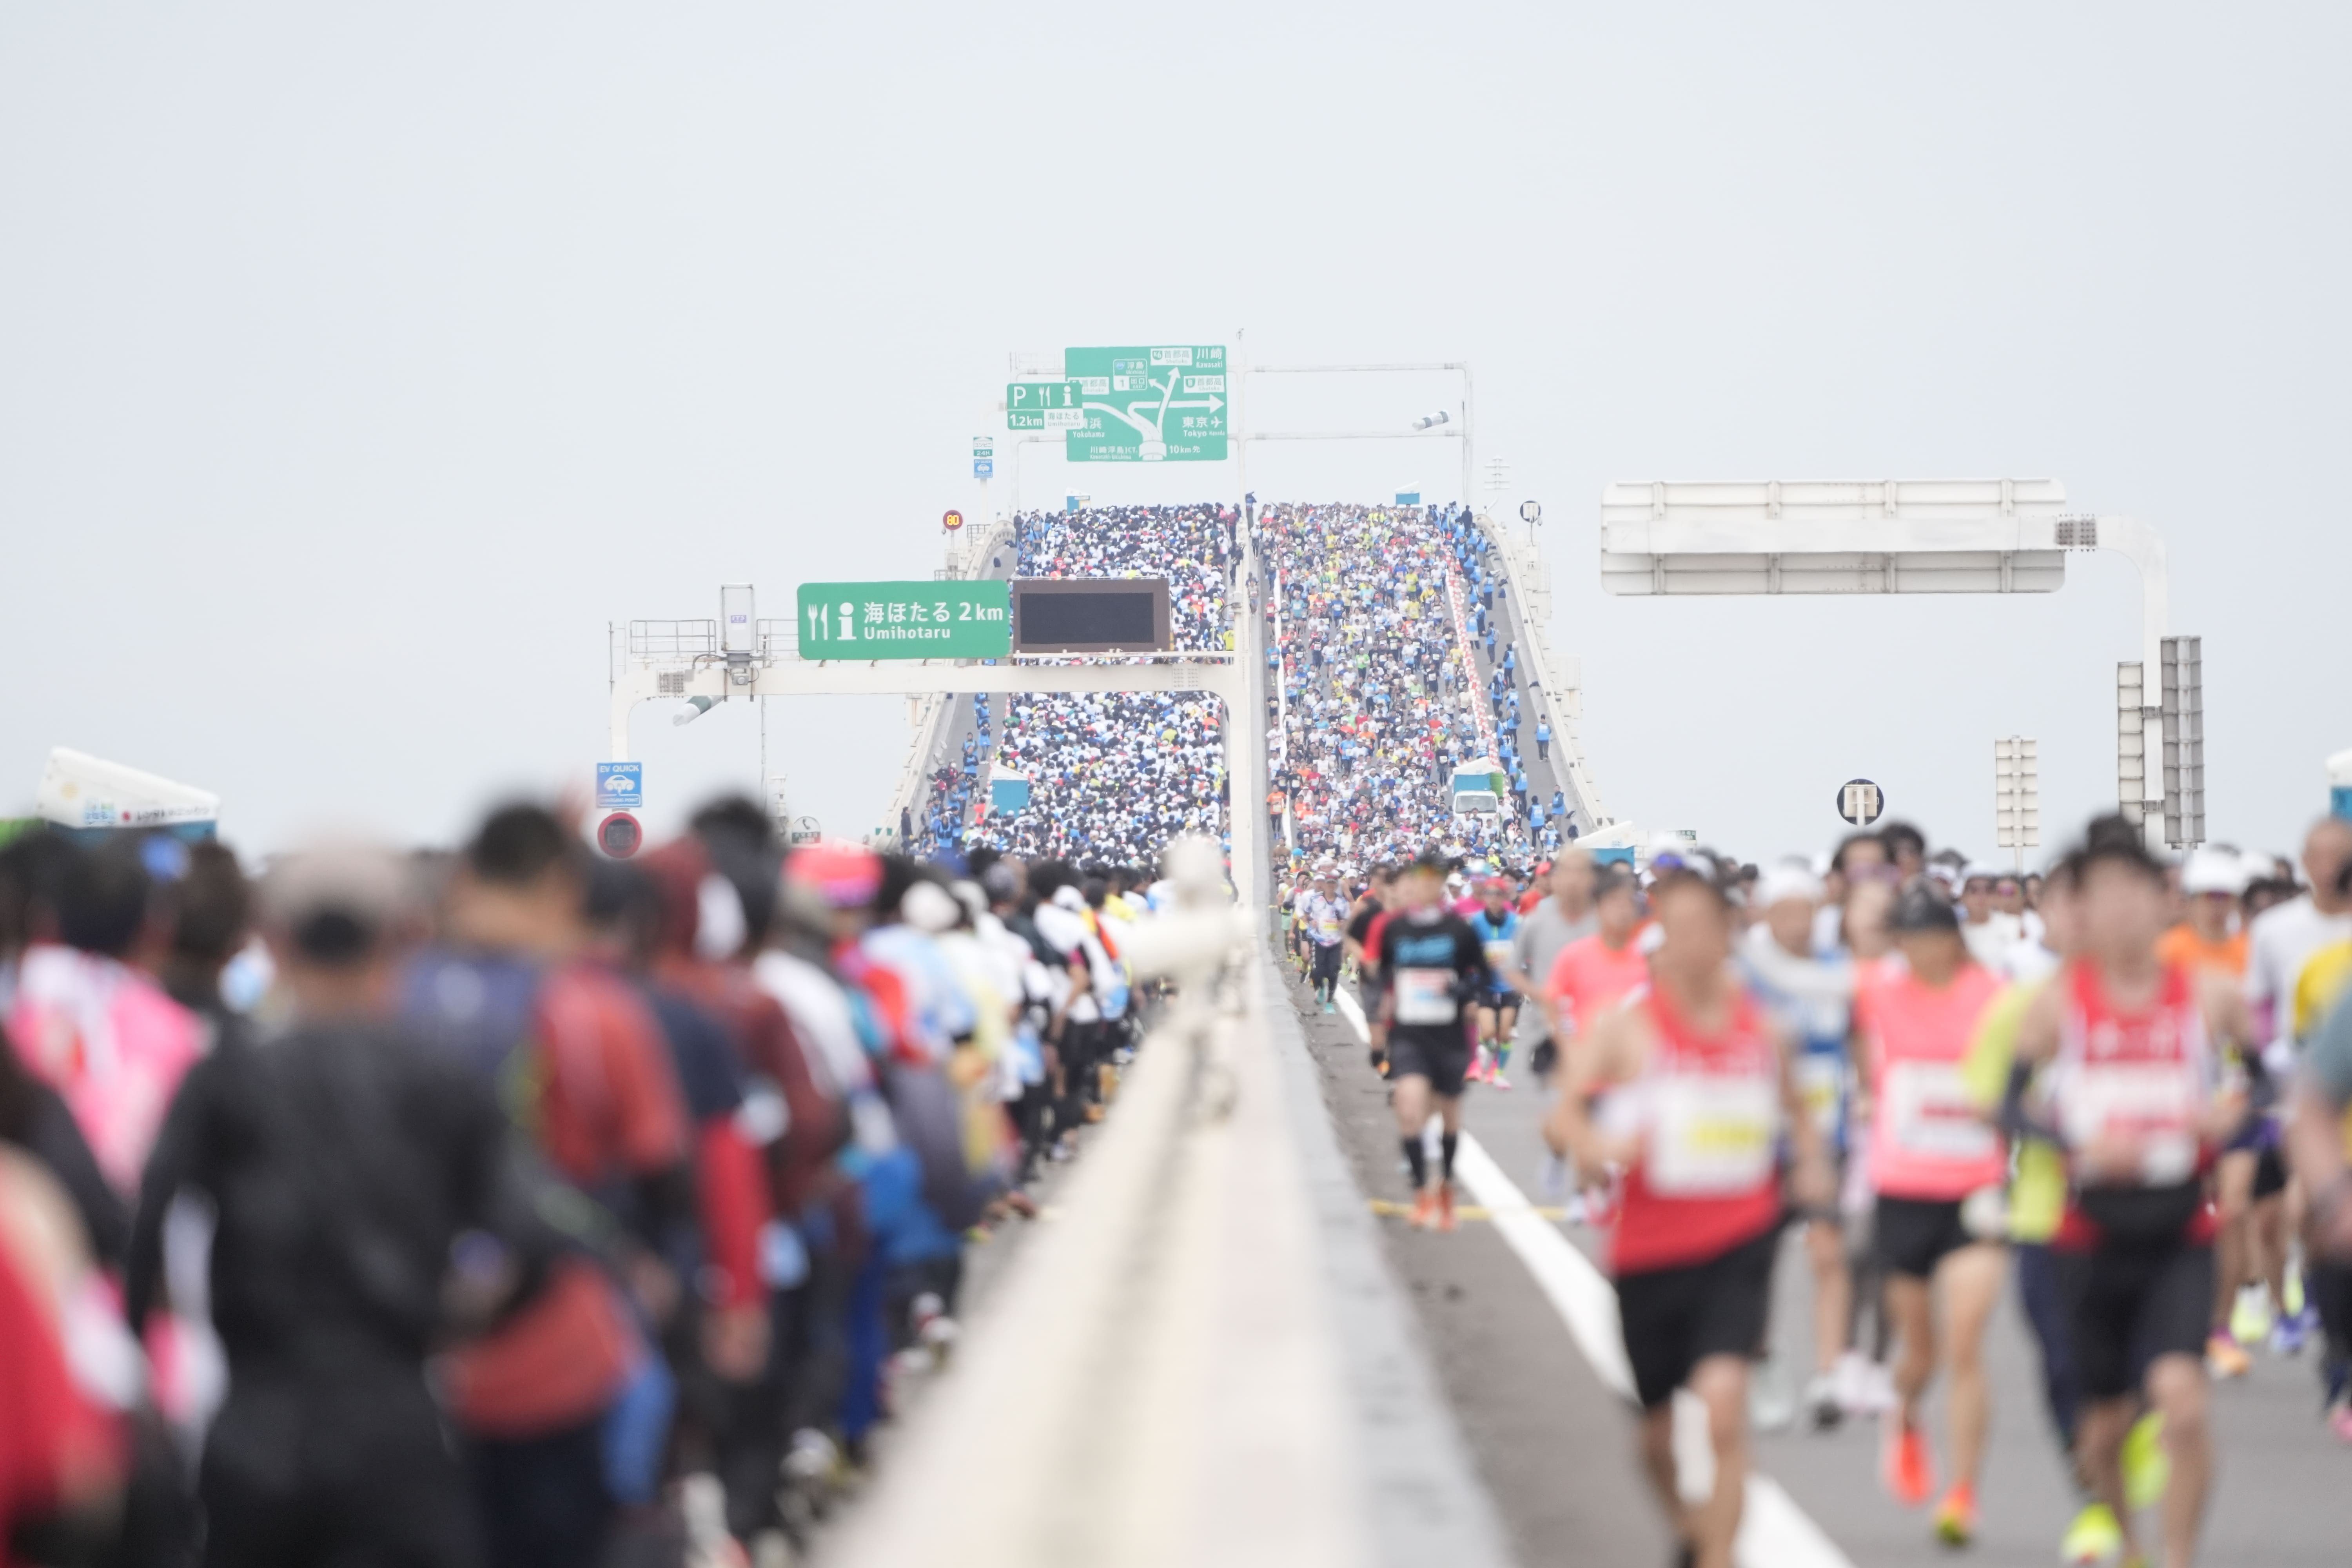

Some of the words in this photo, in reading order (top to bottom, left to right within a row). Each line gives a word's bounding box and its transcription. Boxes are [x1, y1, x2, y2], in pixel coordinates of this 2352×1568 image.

[1196, 347, 1223, 359] 川崎
[1120, 379, 1124, 387] 1
[1014, 386, 1026, 407] P
[1048, 412, 1080, 421] 海ほたる
[1182, 416, 1208, 428] 東京
[1183, 430, 1207, 439] Tokyo
[947, 514, 960, 526] 80
[864, 602, 950, 624] 海ほたる
[864, 627, 950, 640] Umihotaru
